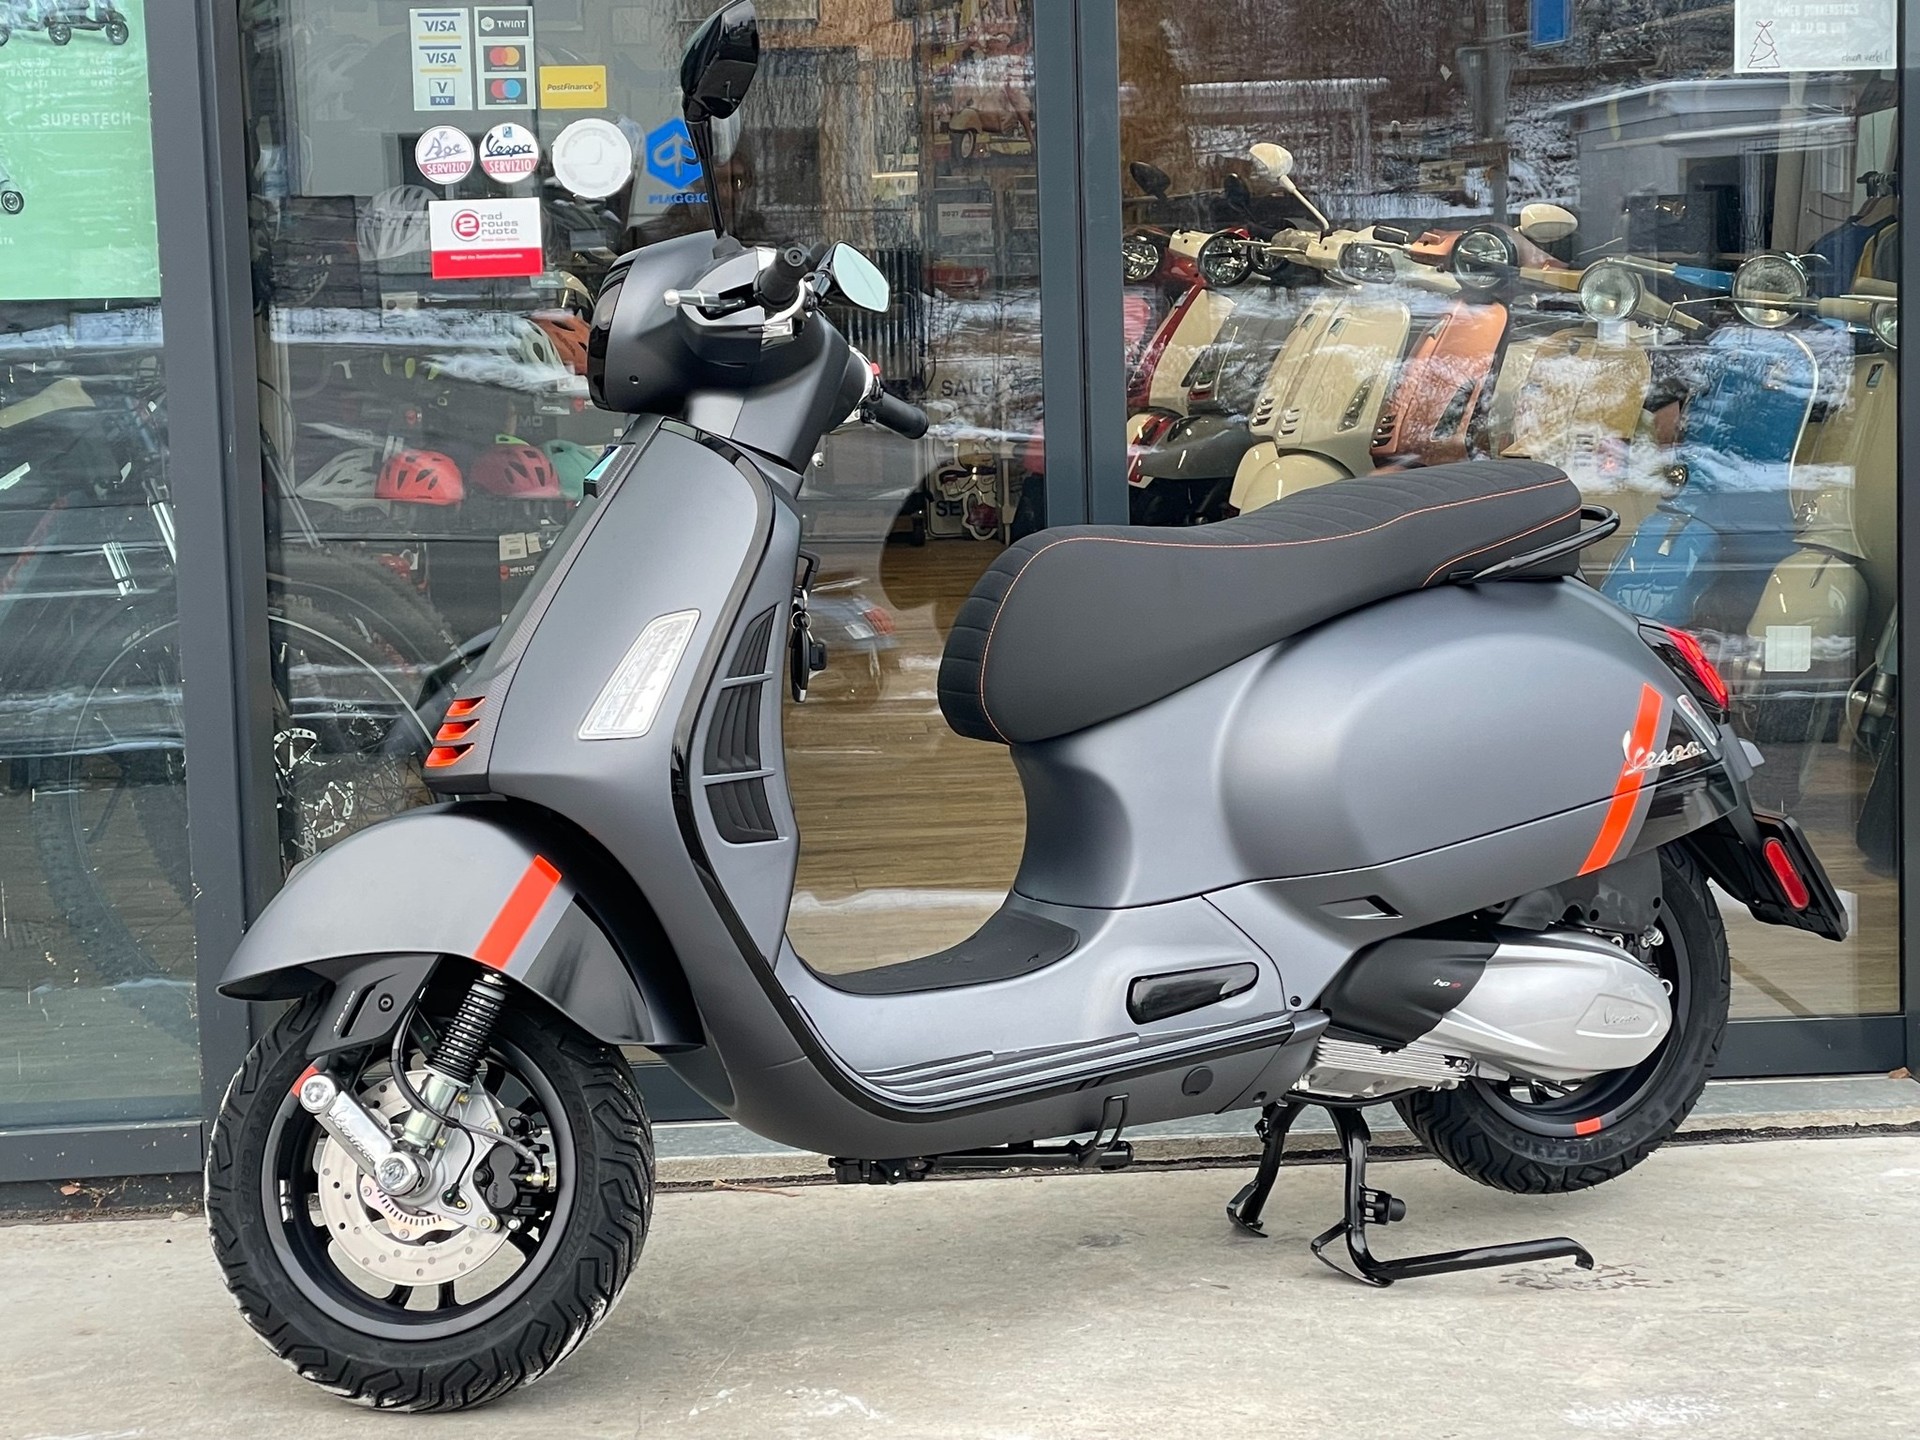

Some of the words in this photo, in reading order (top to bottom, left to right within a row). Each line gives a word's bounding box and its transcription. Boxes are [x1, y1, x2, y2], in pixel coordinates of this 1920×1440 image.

[424, 20, 457, 32] VISA
[497, 20, 526, 29] TWINT
[426, 52, 457, 64] VISA
[436, 81, 448, 94] V
[547, 82, 593, 91] PostFinance
[40, 112, 131, 127] SUPERTECH
[484, 133, 534, 158] Vespa
[427, 162, 467, 175] SERVIZIO
[488, 159, 532, 174] SERVIZIO
[480, 212, 503, 221] rad
[481, 220, 519, 228] roues
[1622, 730, 1707, 777] Vespa
